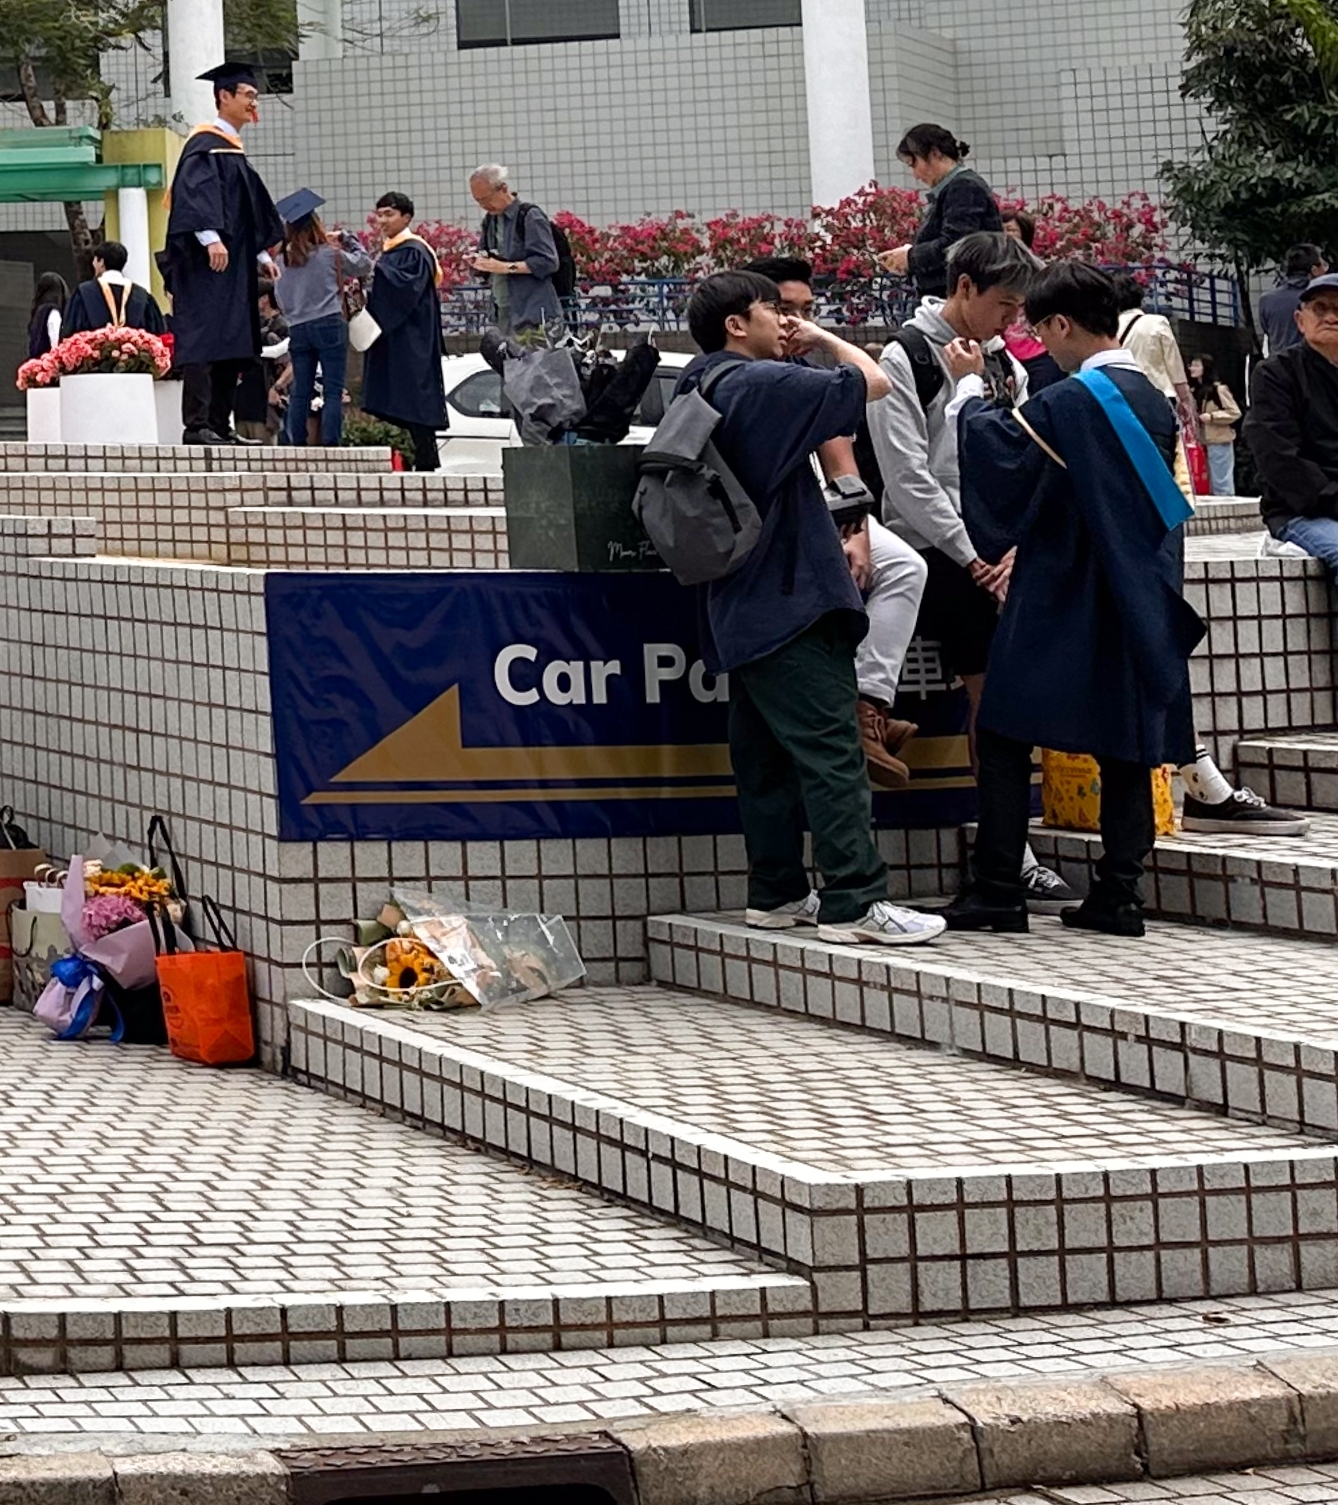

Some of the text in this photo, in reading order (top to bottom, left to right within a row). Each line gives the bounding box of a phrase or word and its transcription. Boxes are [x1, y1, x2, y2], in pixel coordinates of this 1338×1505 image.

[494, 642, 731, 706] Car Pa
[897, 635, 965, 701] 車
